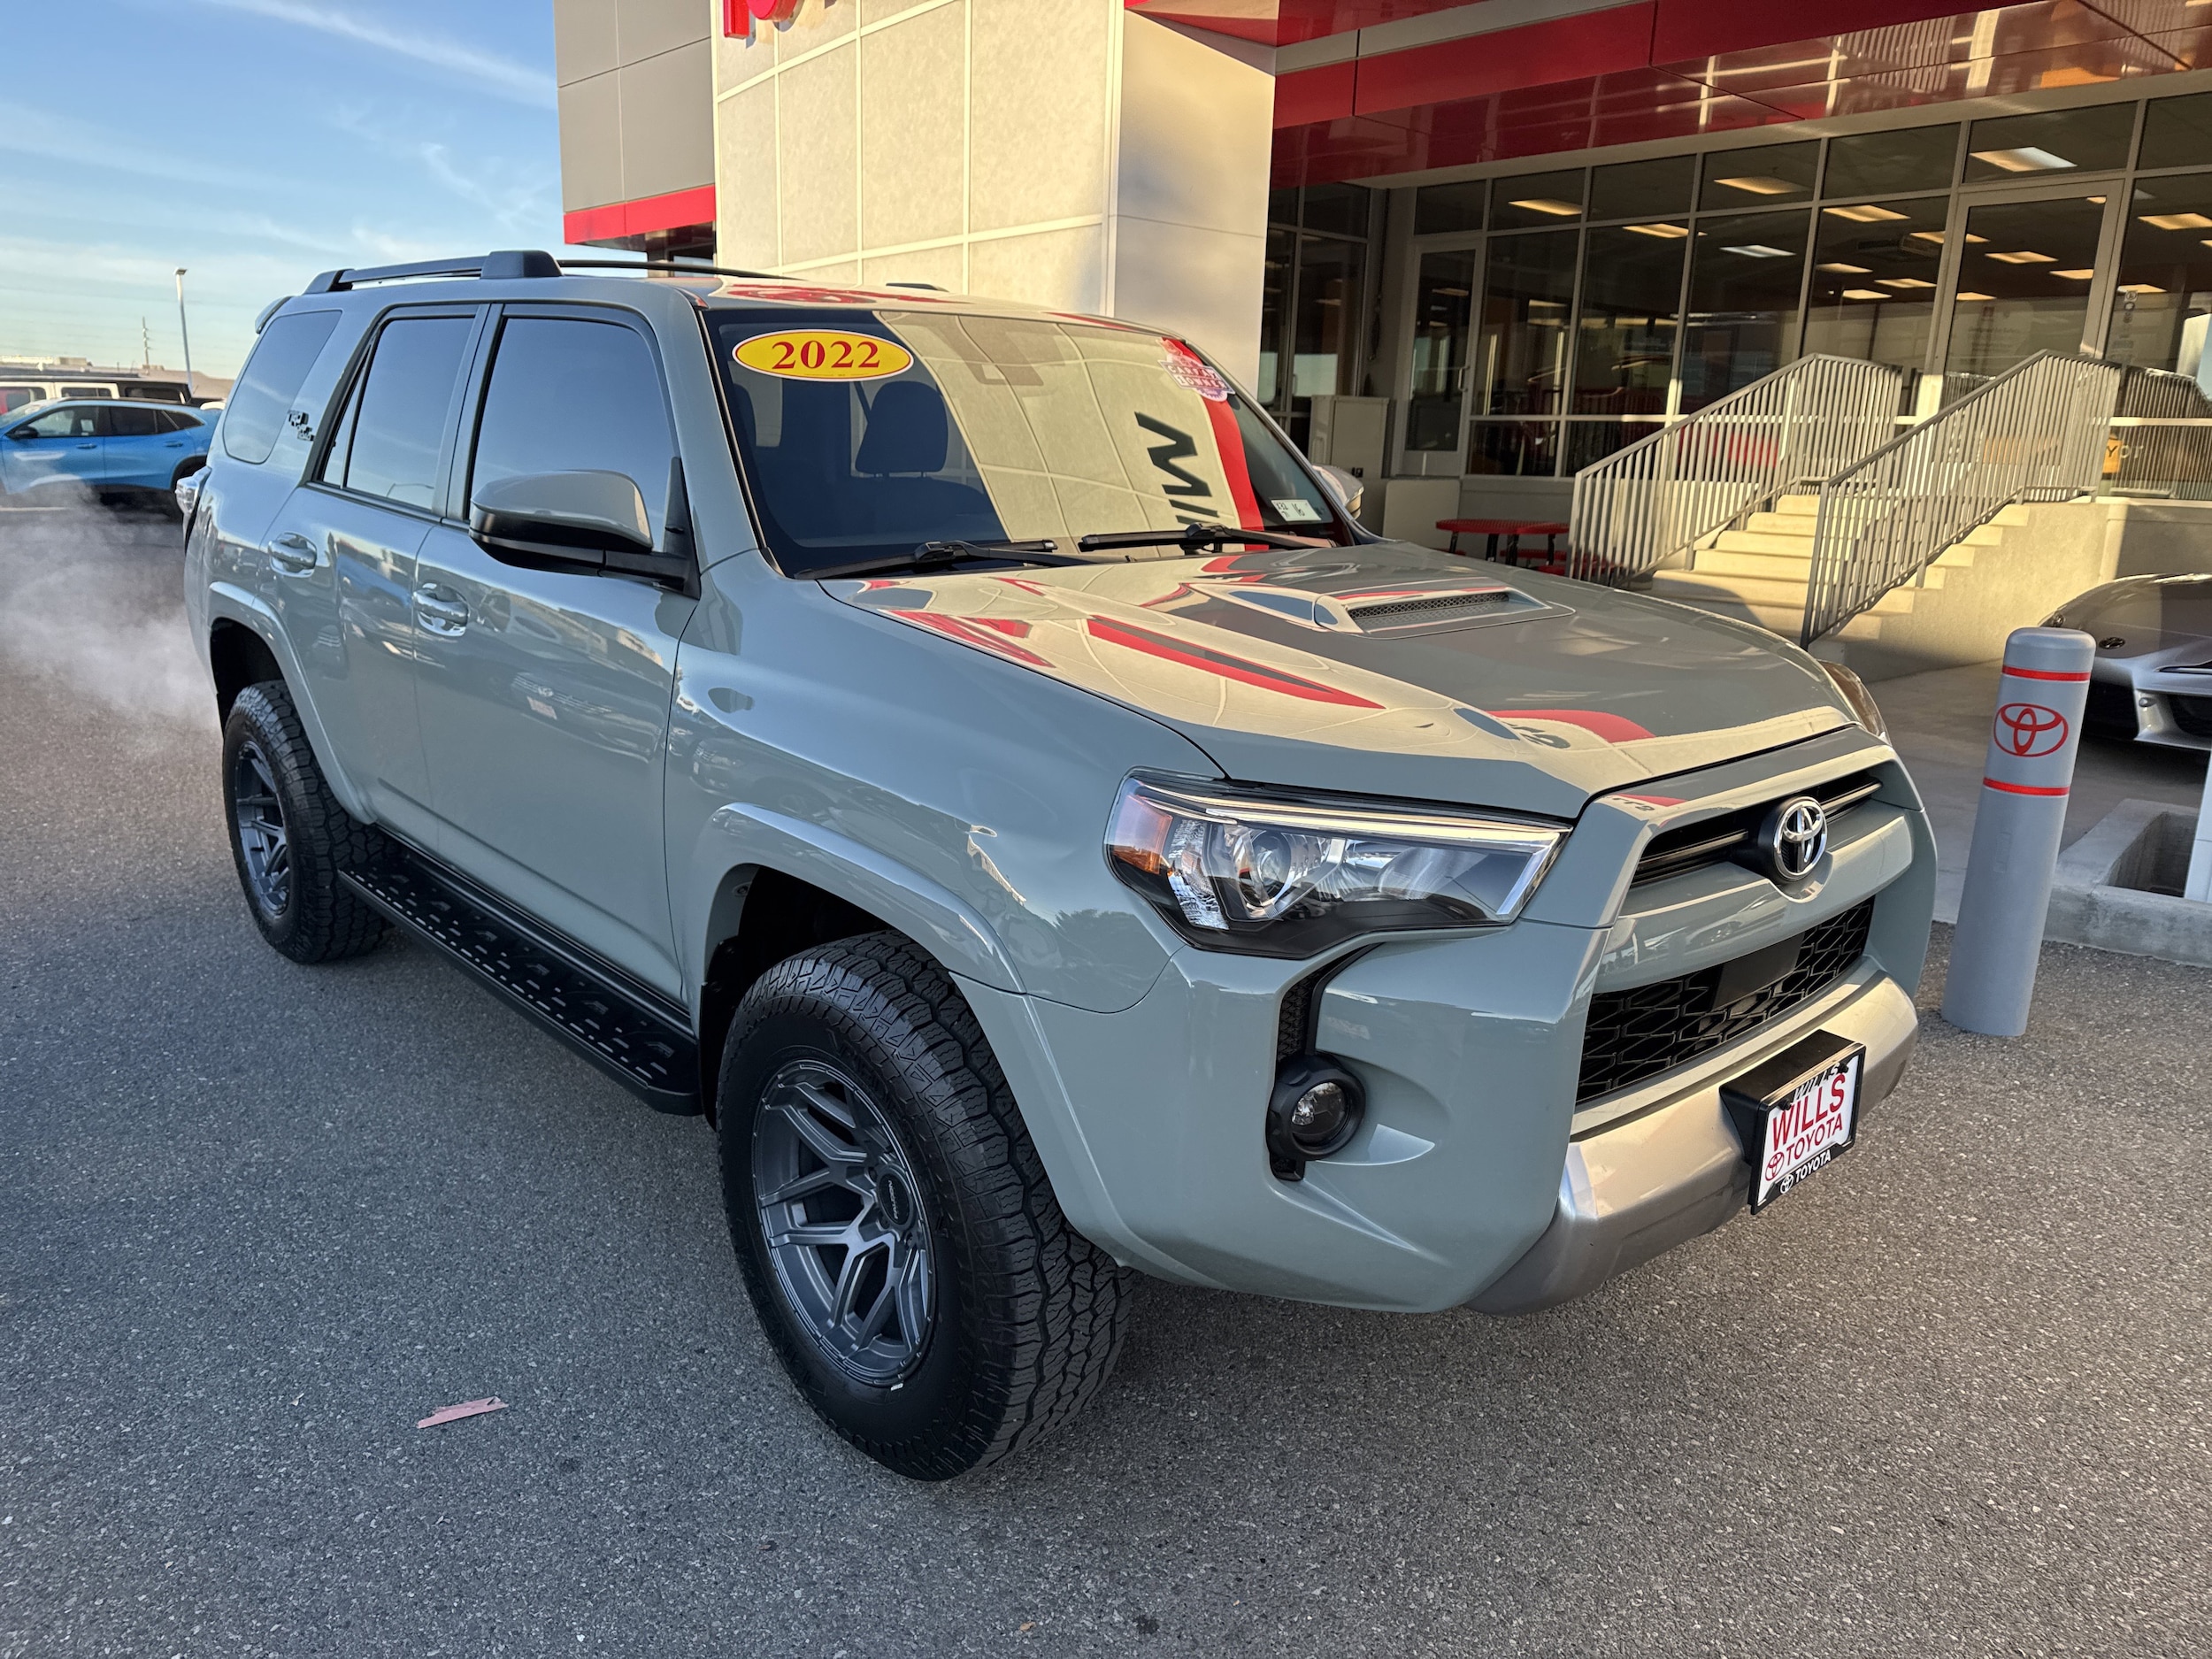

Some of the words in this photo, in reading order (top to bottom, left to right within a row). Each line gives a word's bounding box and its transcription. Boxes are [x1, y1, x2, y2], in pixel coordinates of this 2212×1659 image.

[772, 341, 880, 369] 2022
[1167, 365, 1220, 380] CARFAX
[1186, 376, 1227, 389] OWNER
[1772, 1073, 1846, 1151] WILLS
[1786, 1113, 1843, 1166] TOYOTA
[1794, 1149, 1832, 1181] TOYOTA
